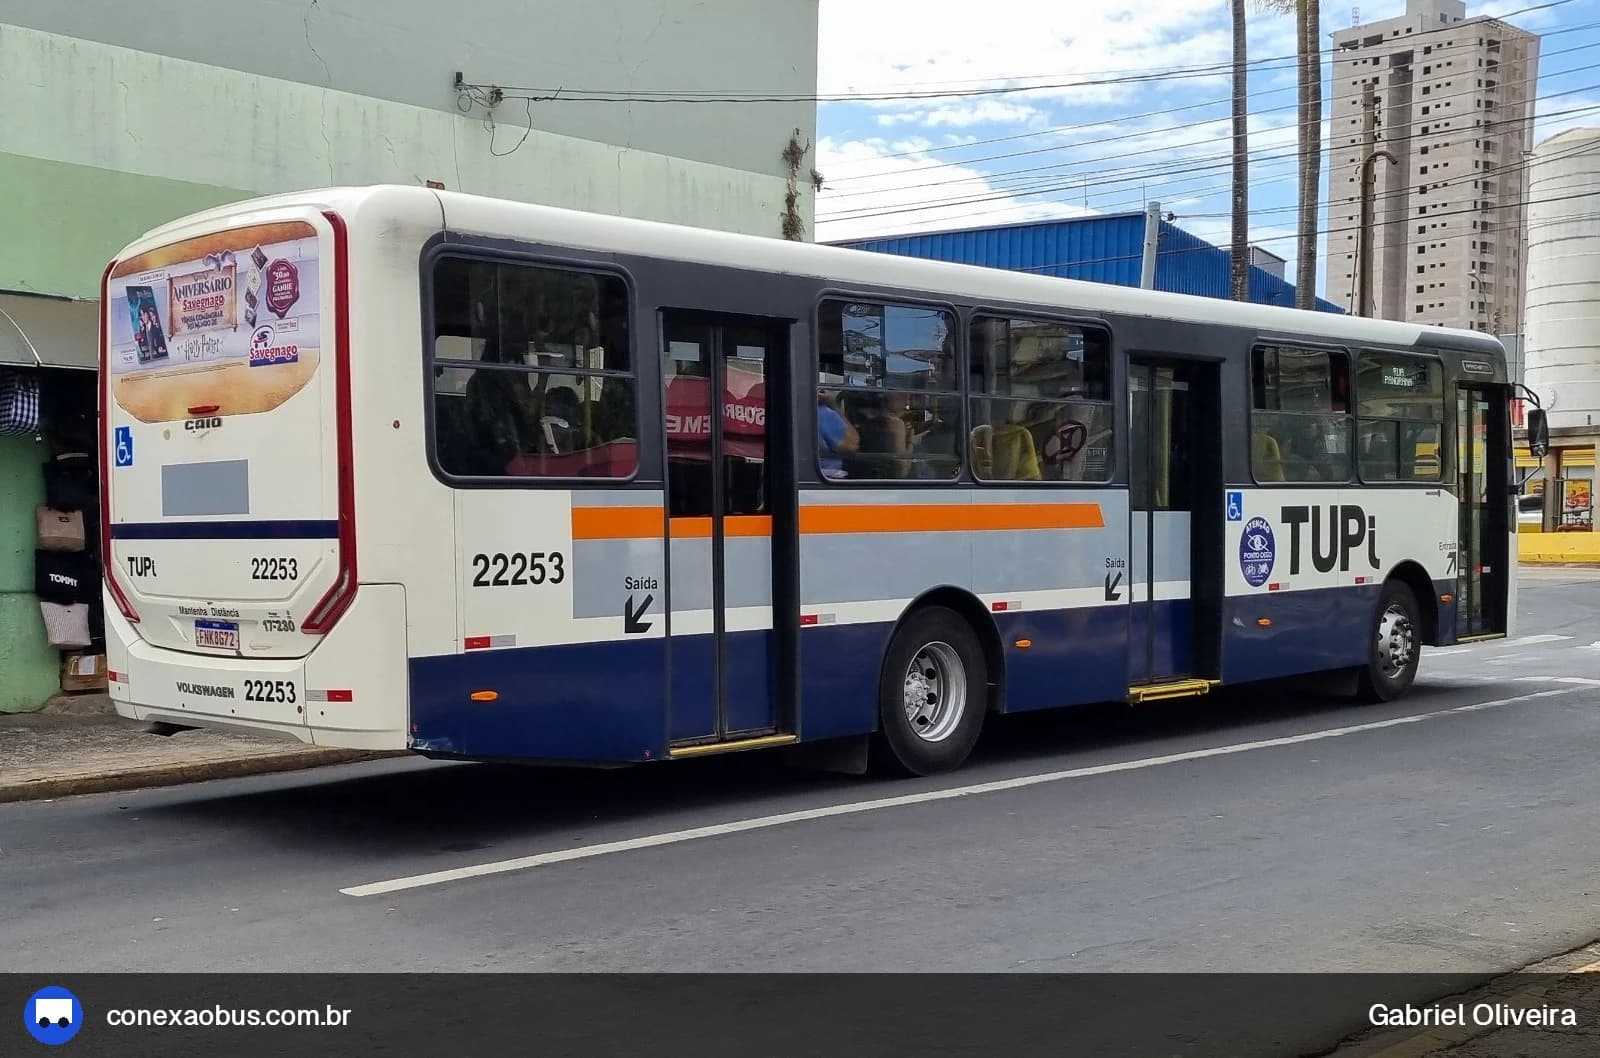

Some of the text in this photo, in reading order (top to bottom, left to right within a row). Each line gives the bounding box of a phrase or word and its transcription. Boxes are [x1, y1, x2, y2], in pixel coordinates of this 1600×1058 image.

[174, 276, 232, 302] ANIVERSÁRIO
[183, 295, 225, 312] Savegnago
[250, 345, 298, 360] Savegnago
[251, 557, 298, 580] 22253
[472, 551, 565, 587] 22253
[624, 576, 658, 590] Saída
[178, 605, 208, 616] Mantenha
[199, 629, 235, 647] FNK8G72
[176, 681, 235, 699] VOLKSWAGEN
[243, 679, 297, 704] 22253
